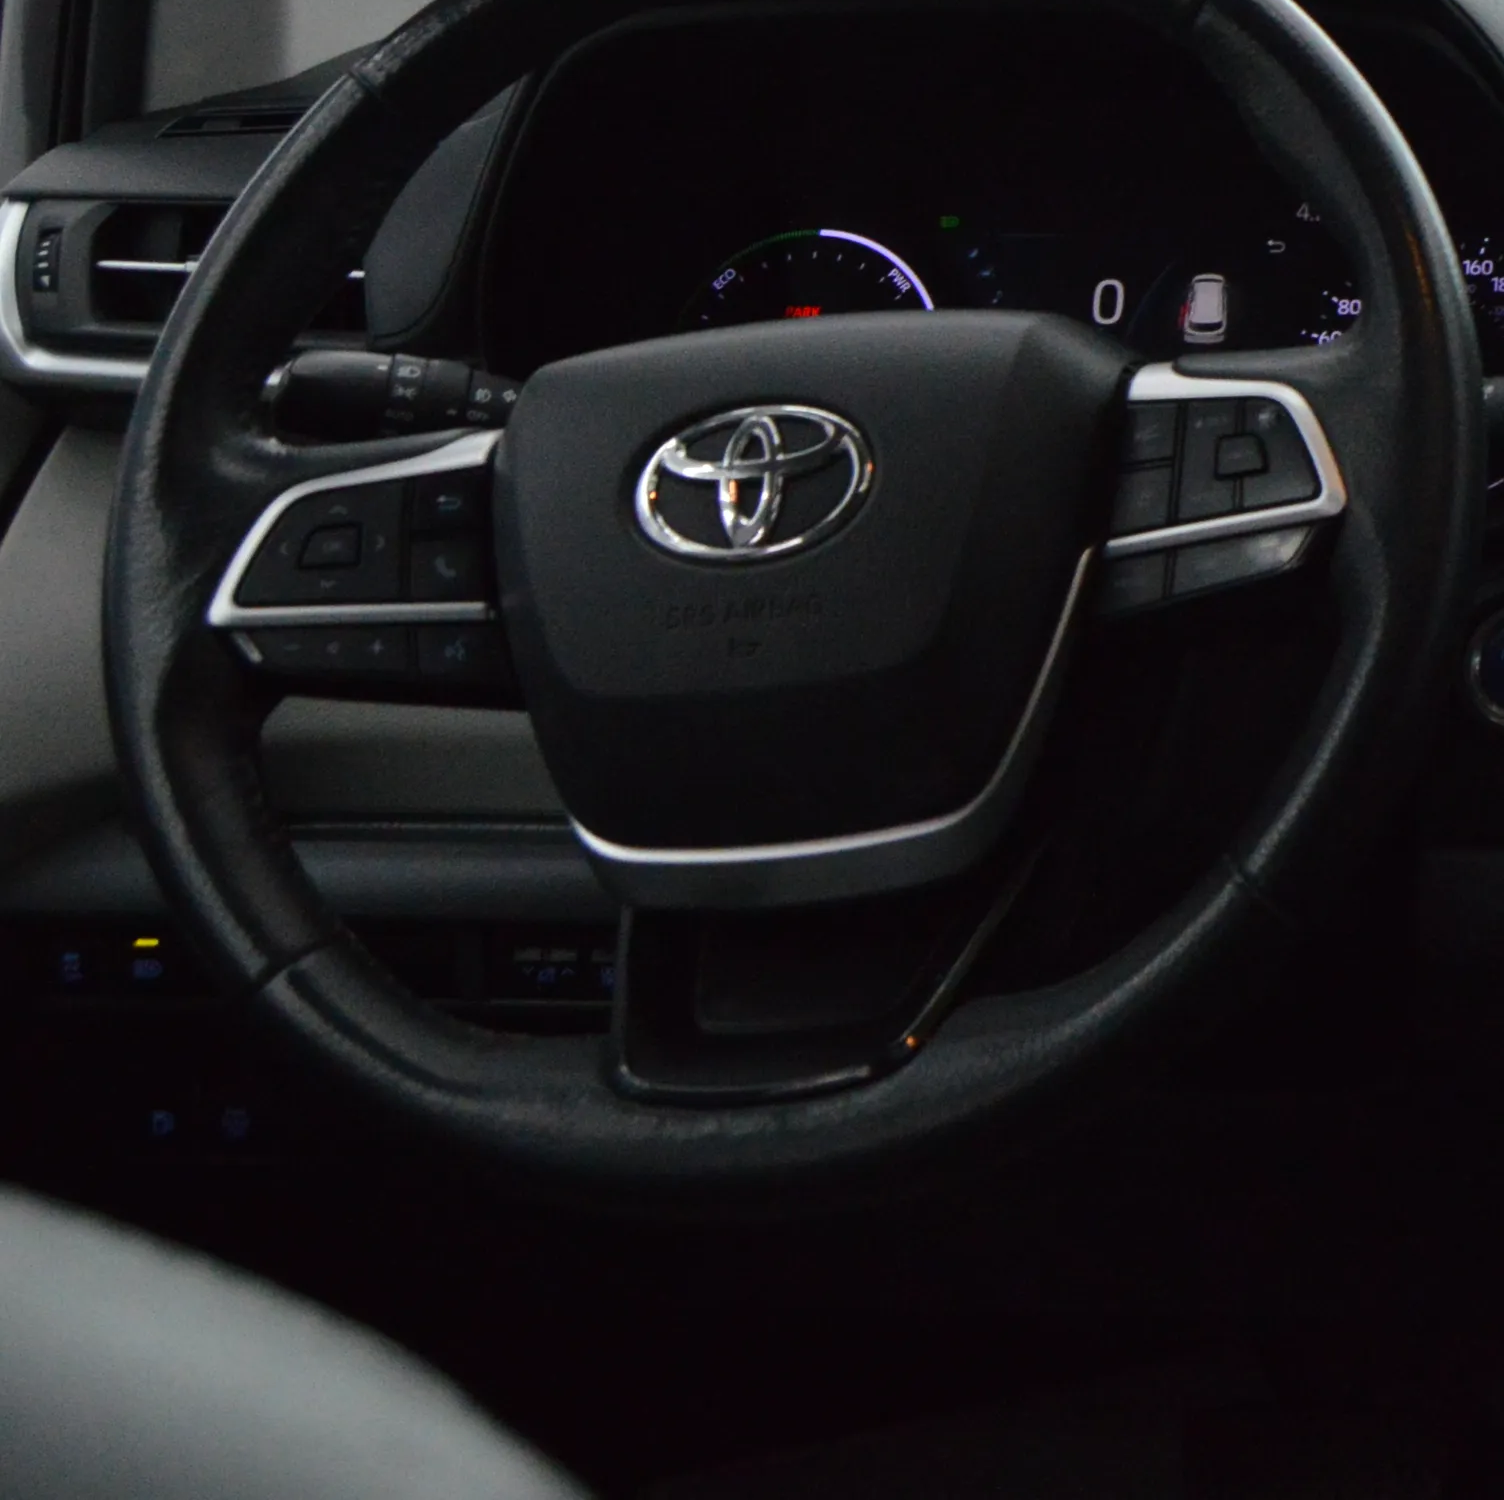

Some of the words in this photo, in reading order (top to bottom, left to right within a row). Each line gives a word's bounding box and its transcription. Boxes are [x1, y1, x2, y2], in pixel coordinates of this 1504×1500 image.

[1462, 259, 1494, 276] 160
[712, 268, 737, 291] ECO
[887, 267, 911, 294] PWR
[784, 305, 822, 318] PARK
[1092, 277, 1125, 327] 0
[1337, 298, 1362, 316] 80
